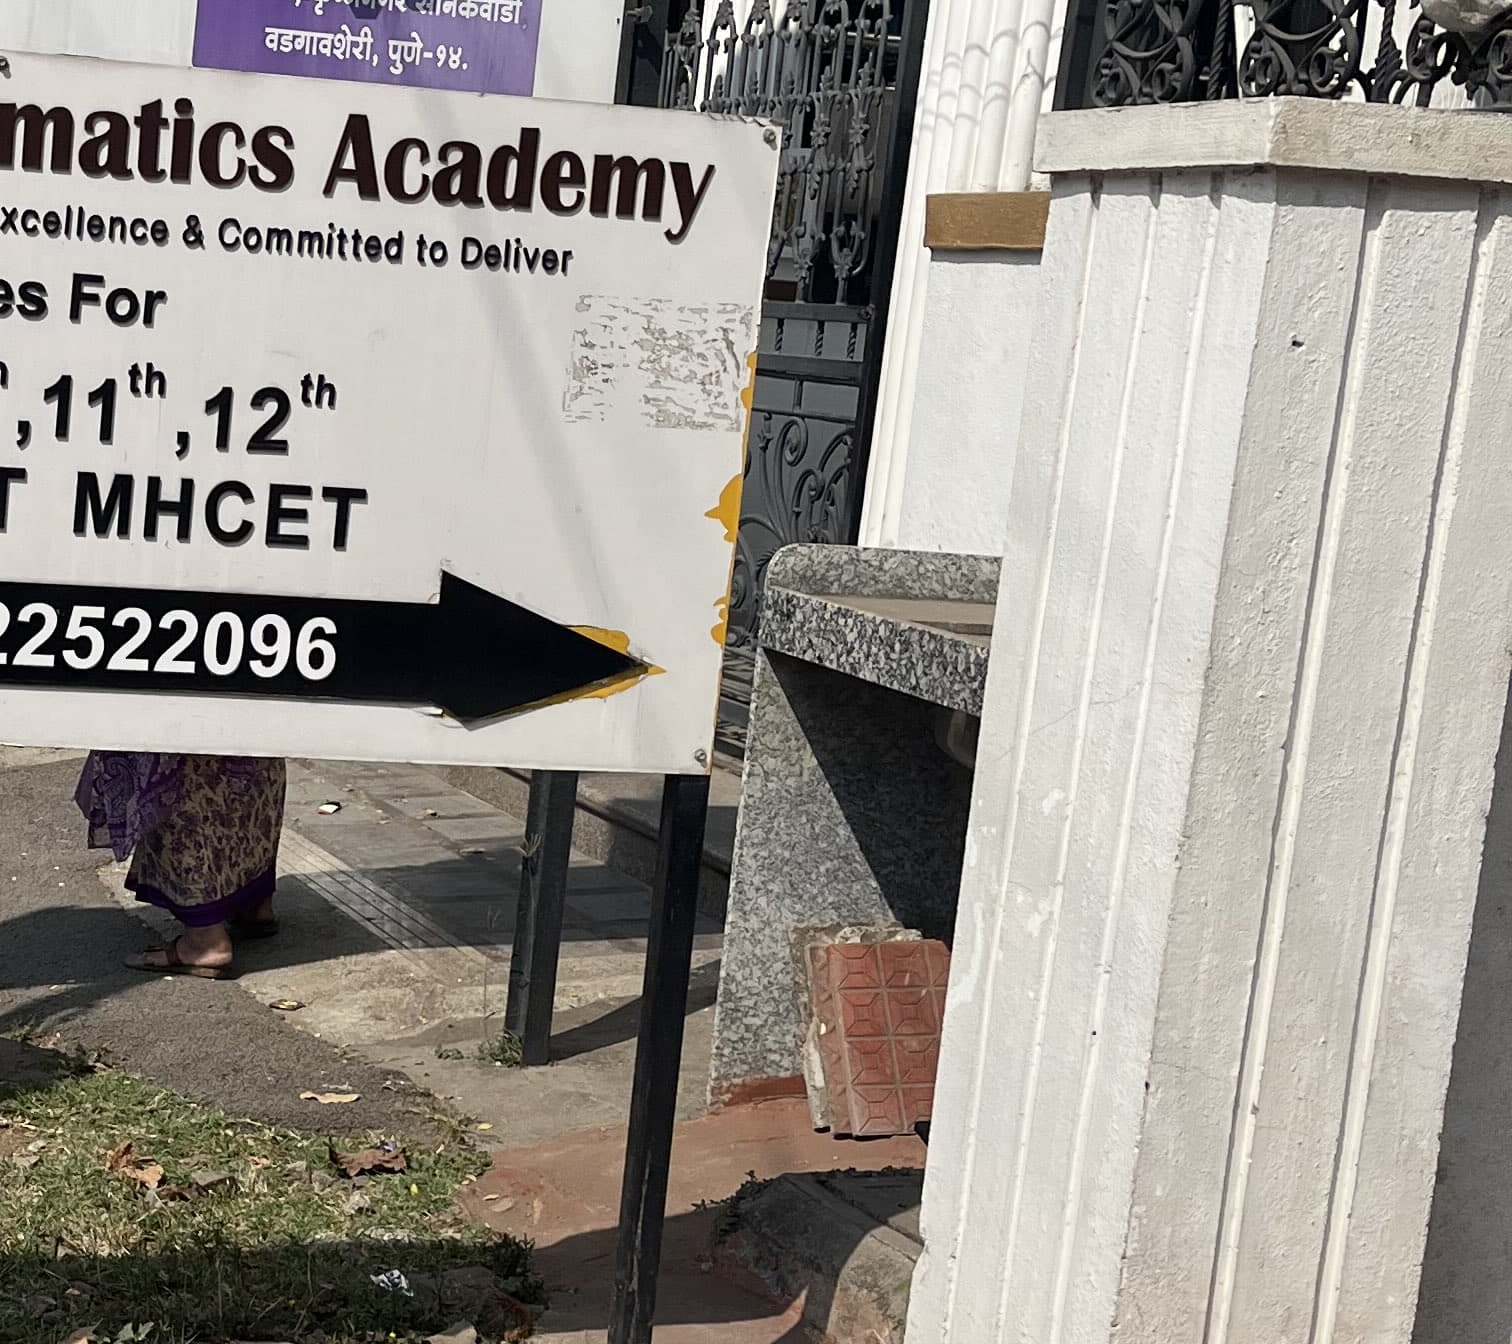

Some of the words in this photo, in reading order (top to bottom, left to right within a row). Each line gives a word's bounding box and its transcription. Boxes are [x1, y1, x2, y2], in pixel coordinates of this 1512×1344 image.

[264, 23, 380, 68] वडगावशेरी,
[322, 112, 717, 245] Academy
[181, 213, 207, 251] &
[217, 216, 405, 265] Committed
[416, 232, 448, 268] to
[460, 236, 574, 277] Deliver
[68, 272, 169, 329] For
[72, 470, 369, 552] MHCET
